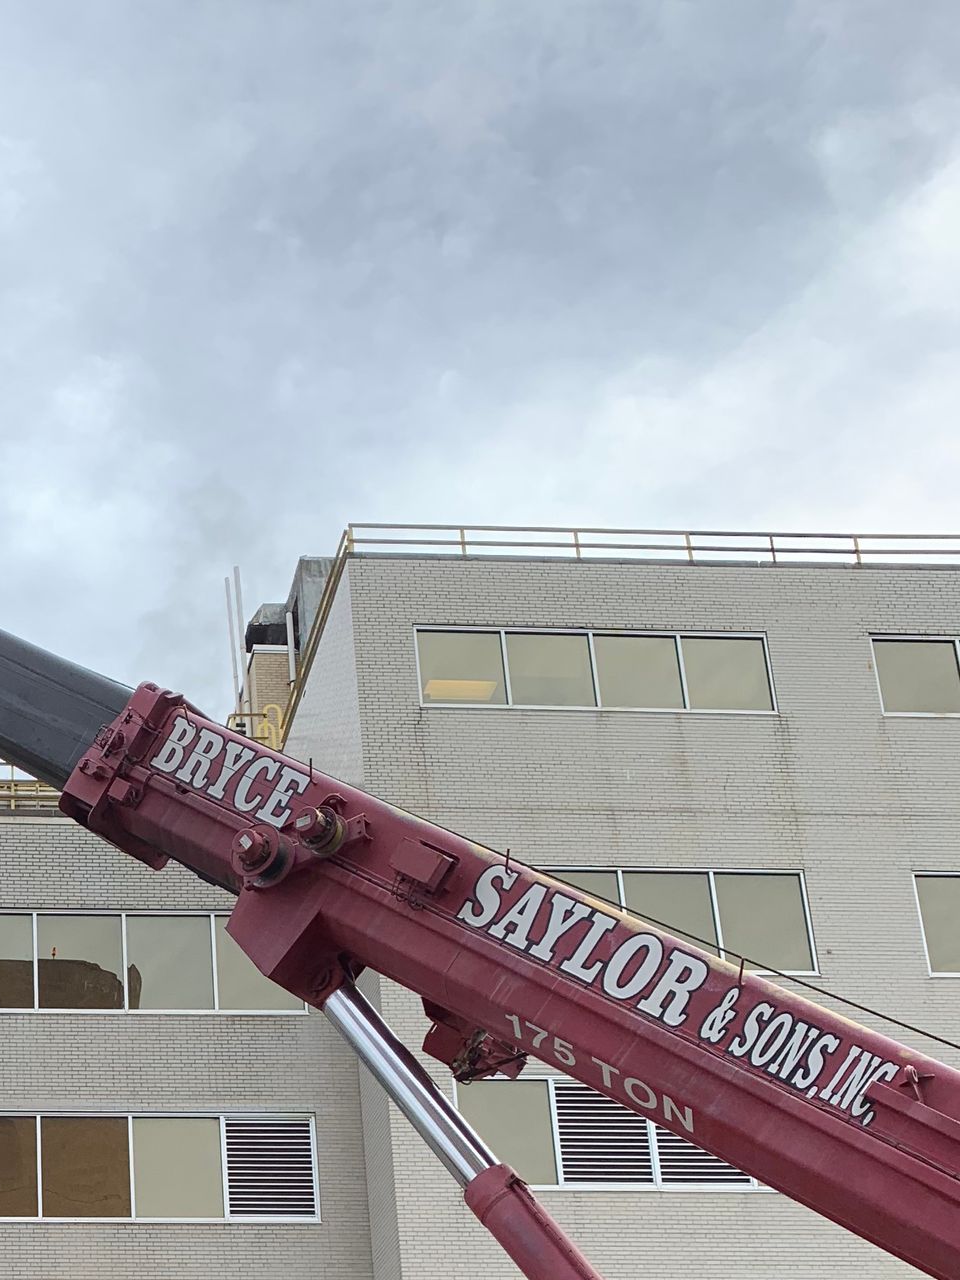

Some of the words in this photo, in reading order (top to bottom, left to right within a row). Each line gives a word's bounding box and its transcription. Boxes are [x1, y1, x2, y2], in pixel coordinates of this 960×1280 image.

[149, 714, 310, 830] BRYCE
[454, 862, 709, 1028] SAYLOR
[700, 986, 741, 1044] &
[504, 1013, 576, 1067] 175
[591, 1055, 695, 1133] TON
